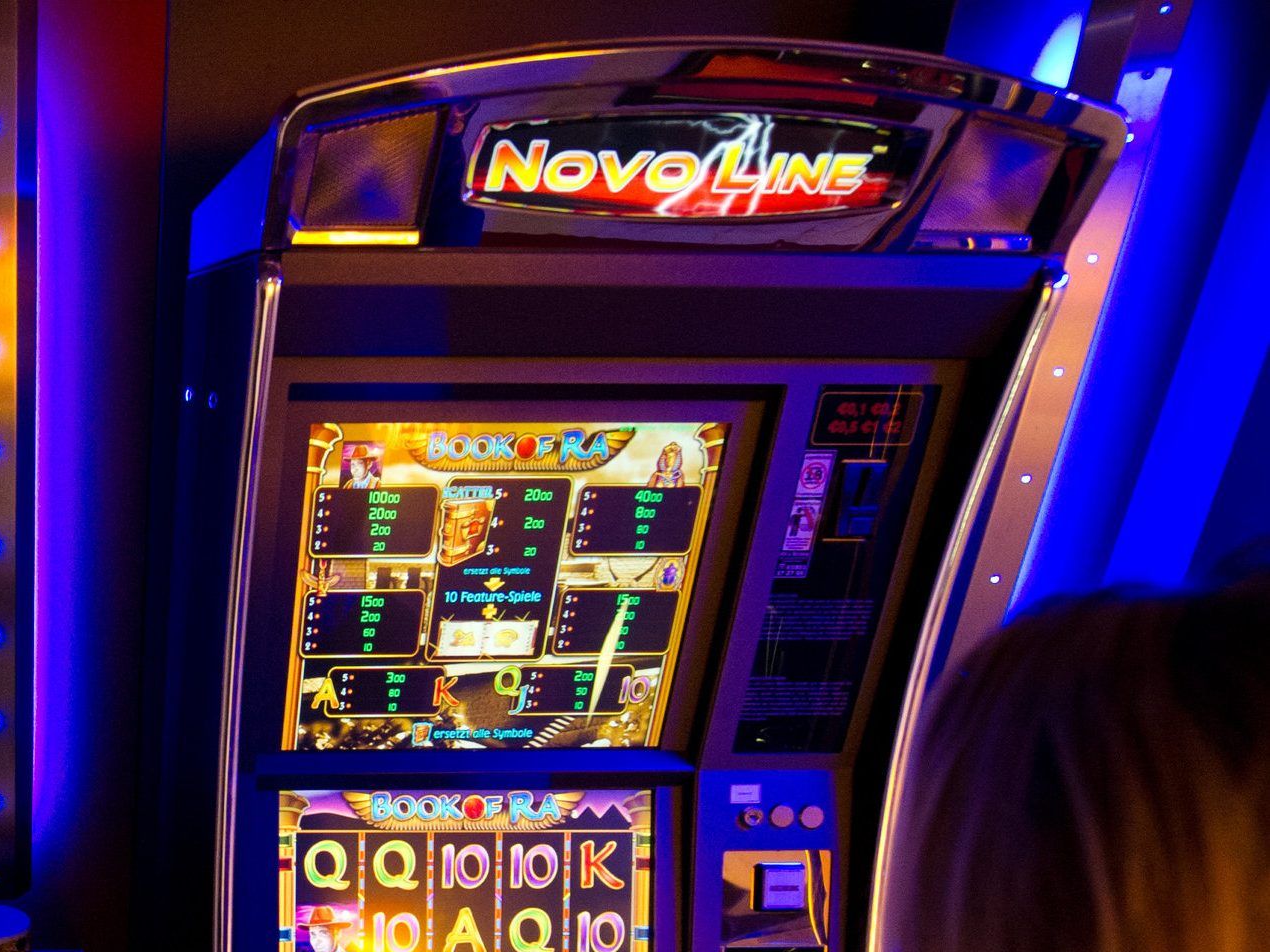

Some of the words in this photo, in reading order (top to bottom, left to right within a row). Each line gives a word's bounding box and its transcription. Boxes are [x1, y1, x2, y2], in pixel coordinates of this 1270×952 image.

[427, 430, 515, 460] BOOK
[559, 430, 610, 462] RA
[319, 492, 326, 502] 5
[368, 491, 400, 504] 10000
[494, 489, 503, 500] 5
[524, 488, 553, 502] 2000
[583, 491, 591, 501] 5
[635, 490, 664, 503] 4000
[317, 508, 324, 518] 4
[368, 507, 397, 520] 2000
[580, 507, 588, 516] 4
[634, 506, 656, 519] 800
[315, 524, 322, 534] 3
[370, 523, 391, 536] 200
[491, 517, 499, 528] 4
[524, 516, 545, 530] 200
[577, 523, 585, 533] 3
[314, 540, 321, 550] 2
[372, 541, 386, 552] 20
[575, 538, 583, 549] 2
[634, 540, 646, 550] 10
[486, 545, 494, 555] 3
[523, 547, 537, 557] 20
[503, 567, 531, 576] Symbole
[309, 596, 316, 606] 5
[360, 595, 385, 608] 1500
[444, 591, 458, 603] 10
[460, 590, 542, 604] Feature-Spiele
[564, 595, 572, 604] 5
[616, 594, 640, 606] 1500
[360, 610, 381, 623] 200
[562, 610, 569, 619] 4
[306, 626, 312, 636] 3
[559, 624, 567, 634] 3
[305, 641, 311, 651] 2
[363, 642, 373, 652] 10
[557, 640, 564, 649] 2
[342, 672, 349, 682] 5
[385, 672, 406, 684] 300
[493, 664, 523, 697] Q
[530, 671, 538, 680] 5
[573, 670, 594, 682] 200
[311, 677, 340, 709] A
[340, 687, 347, 696] 4
[432, 676, 460, 707] K
[528, 685, 535, 694] 4
[575, 687, 588, 696] 50
[617, 675, 651, 704] 10
[507, 683, 530, 715] J
[525, 700, 532, 709] 3
[574, 701, 584, 710] 10
[338, 701, 345, 711] 3
[387, 702, 397, 711] 10
[433, 729, 470, 739] ersetzt
[473, 728, 490, 739] alle
[492, 727, 533, 740] Symbole
[370, 793, 463, 822] BOOK
[509, 790, 562, 823] RA
[303, 839, 350, 890] Q
[372, 839, 420, 891] Q
[441, 843, 490, 889] 10
[510, 843, 559, 889] 10
[579, 840, 625, 890] K
